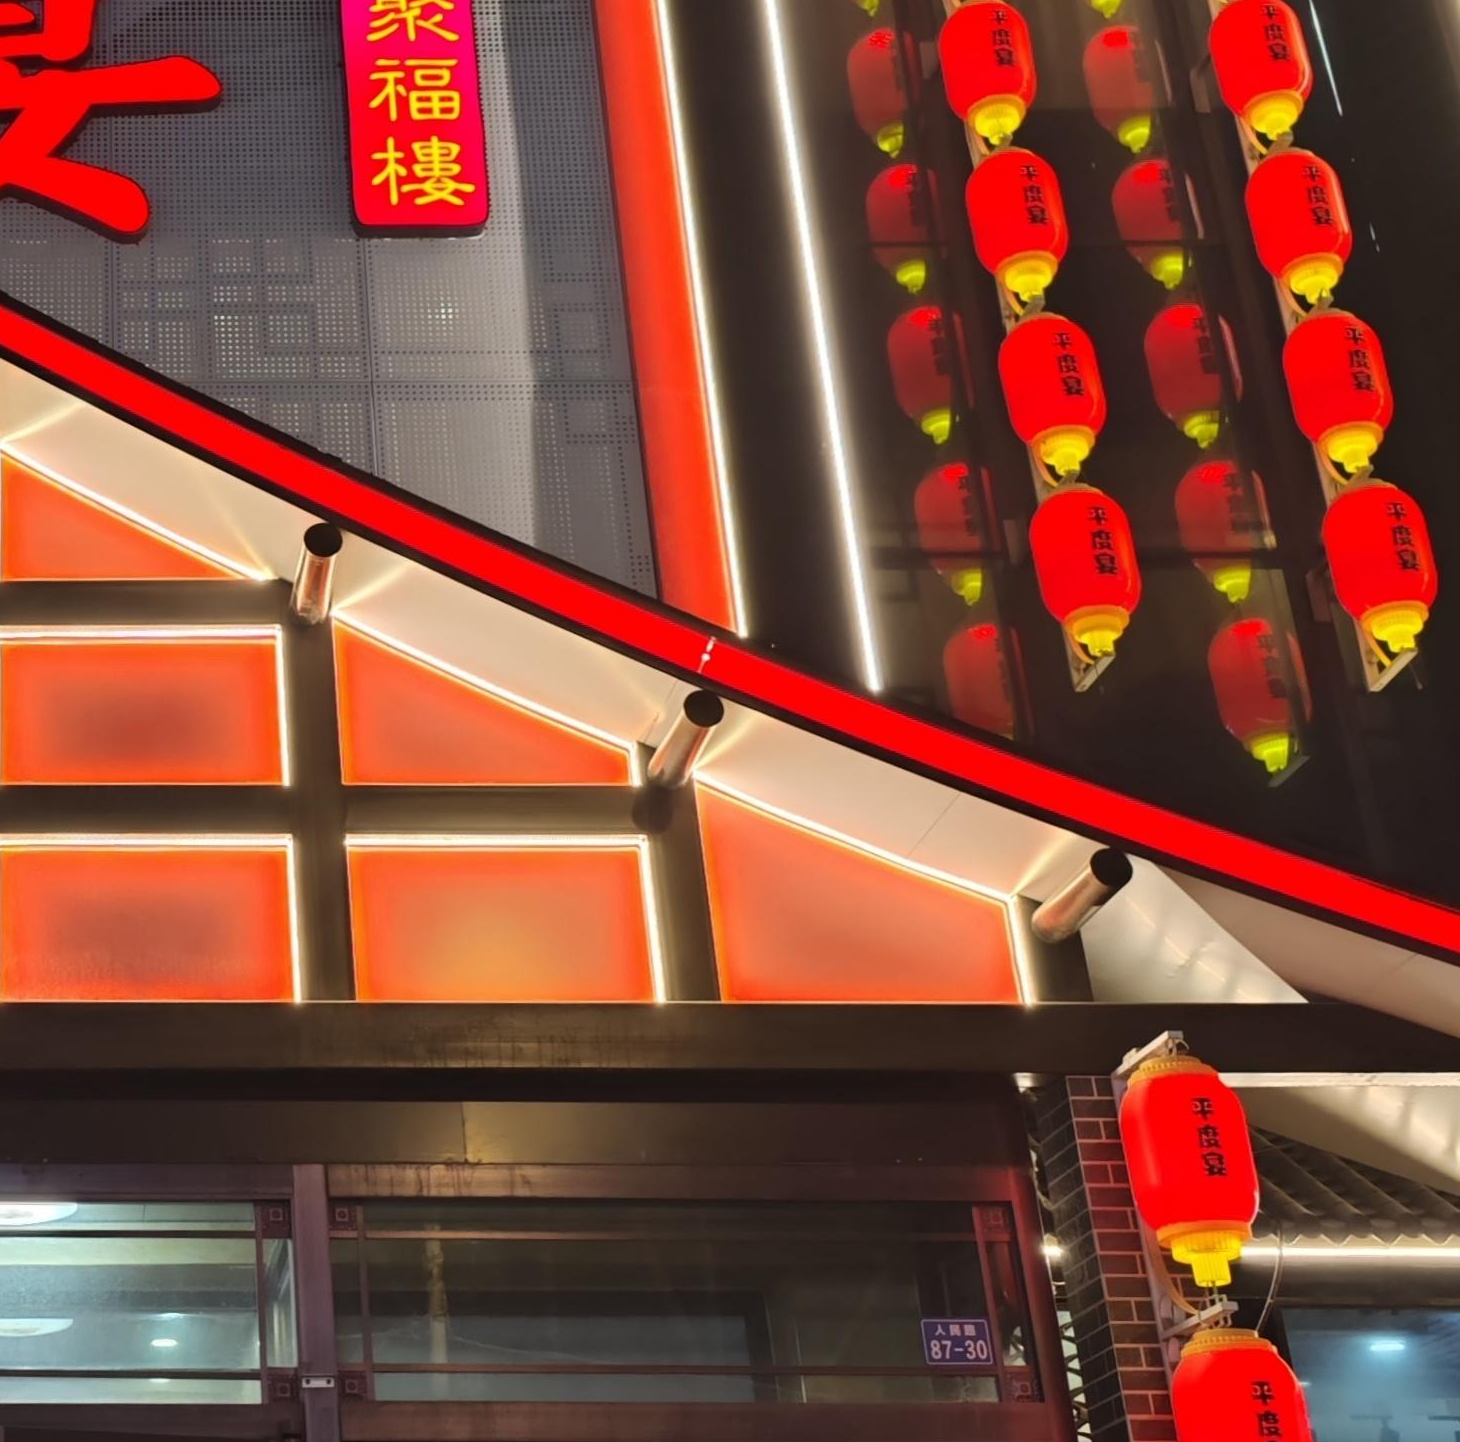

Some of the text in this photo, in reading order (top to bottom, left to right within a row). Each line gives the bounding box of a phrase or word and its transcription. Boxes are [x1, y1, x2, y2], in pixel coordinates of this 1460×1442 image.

[992, 10, 1014, 66] 平度宴
[1260, 4, 1288, 61] 平度宴
[1020, 164, 1048, 224] 平度宴
[1303, 165, 1333, 226] 平度宴
[1053, 332, 1083, 396] 平度宴
[1345, 327, 1374, 392] 平度宴
[1088, 507, 1118, 575] 平度宴
[1386, 502, 1419, 571] 平度宴
[1192, 1097, 1227, 1177] 平度宴
[930, 1339, 988, 1360] 87-30
